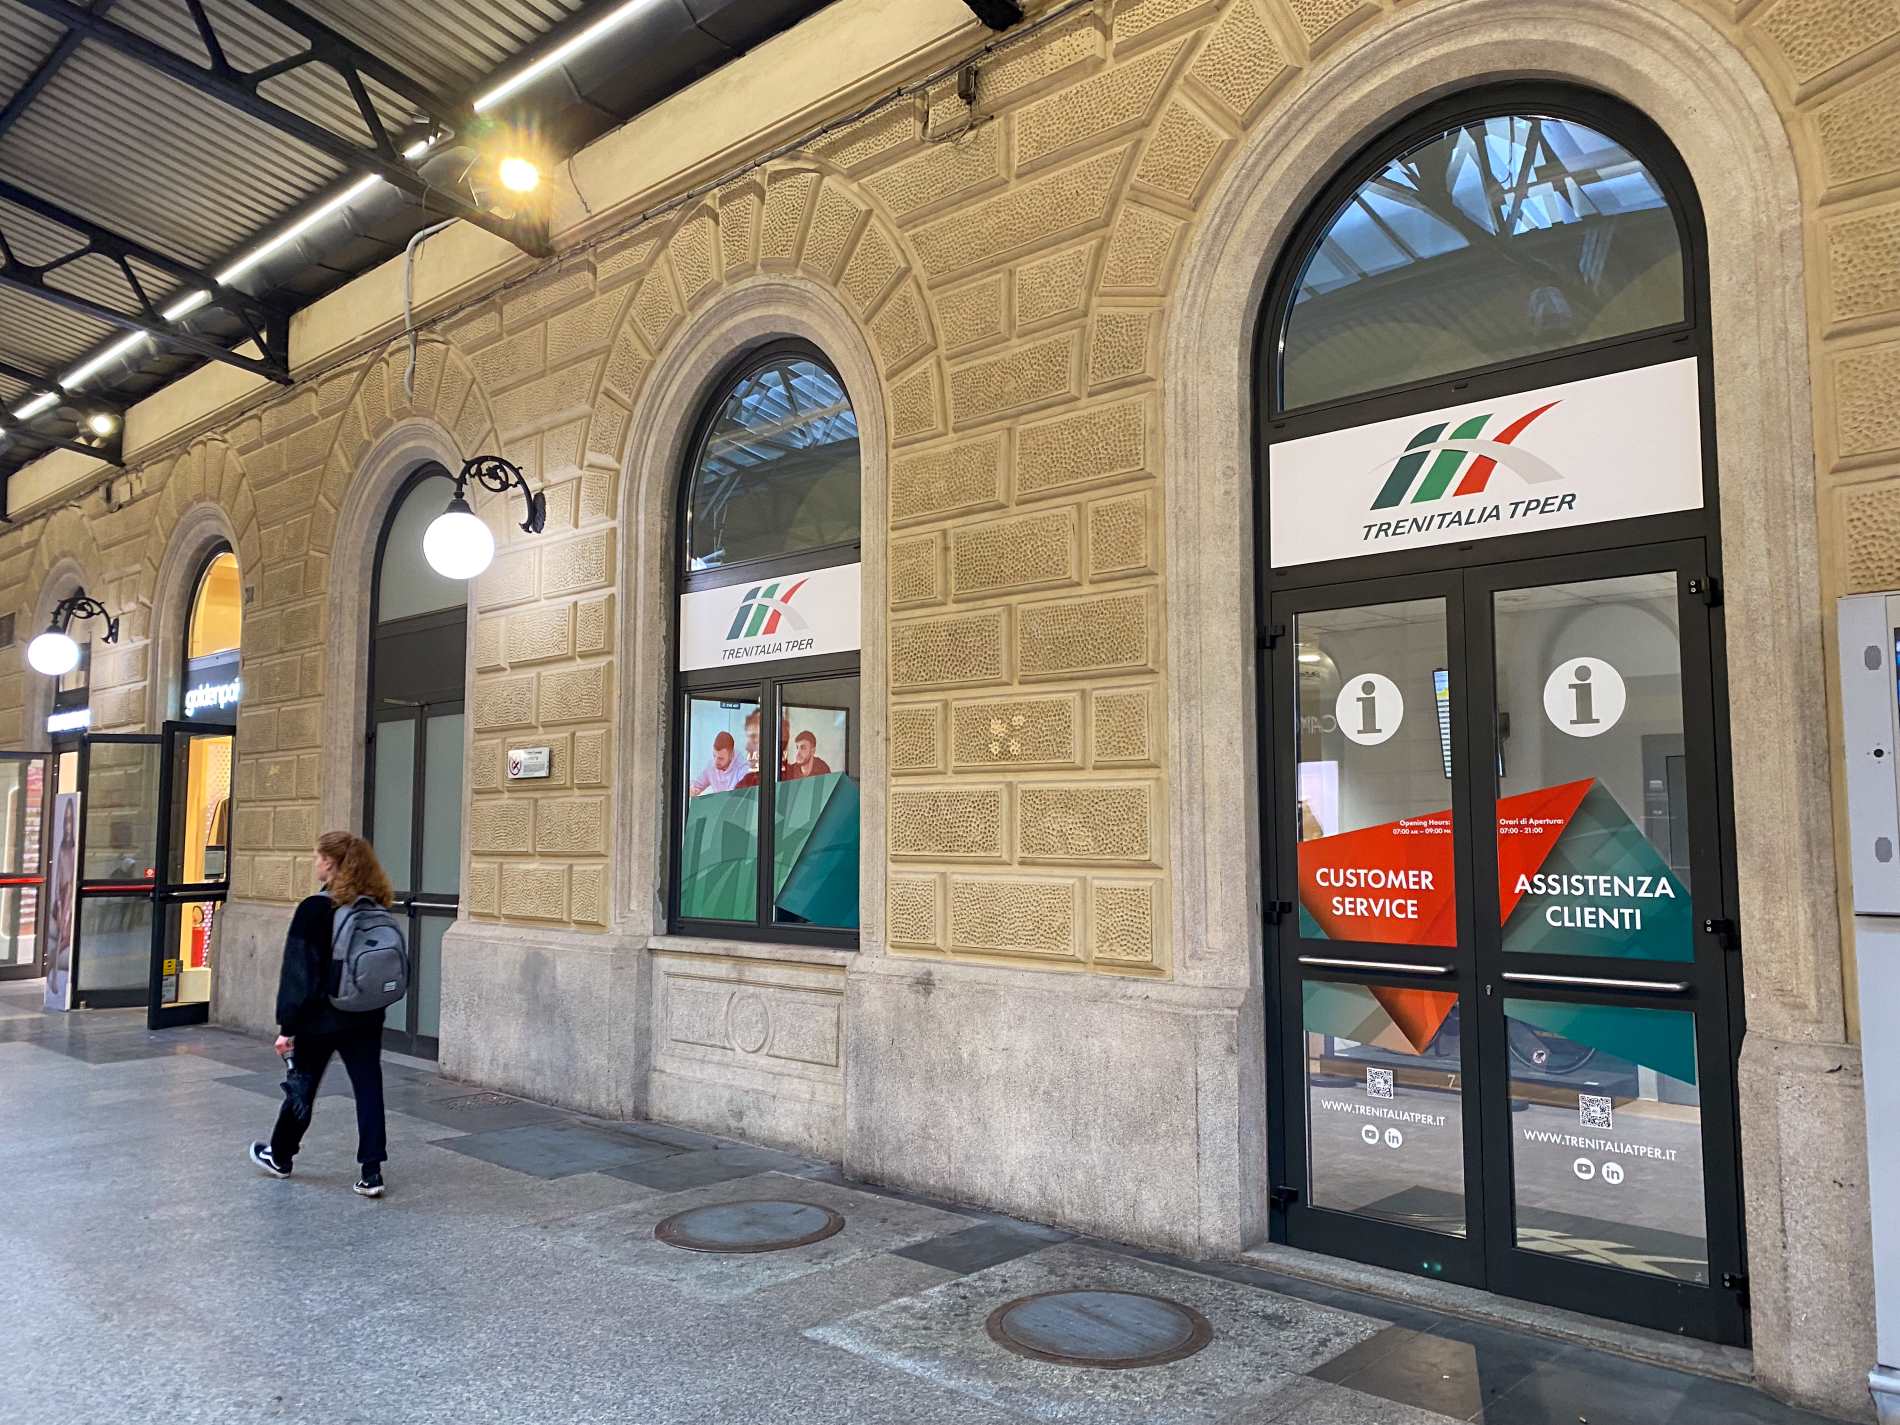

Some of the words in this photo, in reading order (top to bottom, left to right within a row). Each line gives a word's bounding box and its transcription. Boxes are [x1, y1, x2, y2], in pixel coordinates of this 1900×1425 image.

[1363, 505, 1501, 540] TRENITALIA
[1509, 493, 1577, 519] TPER
[722, 642, 782, 660] TRENITALIA
[785, 638, 814, 652] TPER
[1400, 819, 1427, 827] Opening
[1429, 818, 1451, 826] Hours:
[1500, 817, 1518, 825] Orari
[1520, 817, 1528, 825] di
[1529, 818, 1564, 826] Apertura:
[1315, 867, 1434, 891] CUSTOMER
[1514, 873, 1675, 899] ASSISTENZA
[1332, 896, 1418, 919] SERVICE
[1546, 905, 1642, 930] CLIENTI
[1321, 1099, 1446, 1126] WWW.TRENITALIATPER.IT
[1524, 1129, 1677, 1161] WWW.TRENITALIATPER.IT
